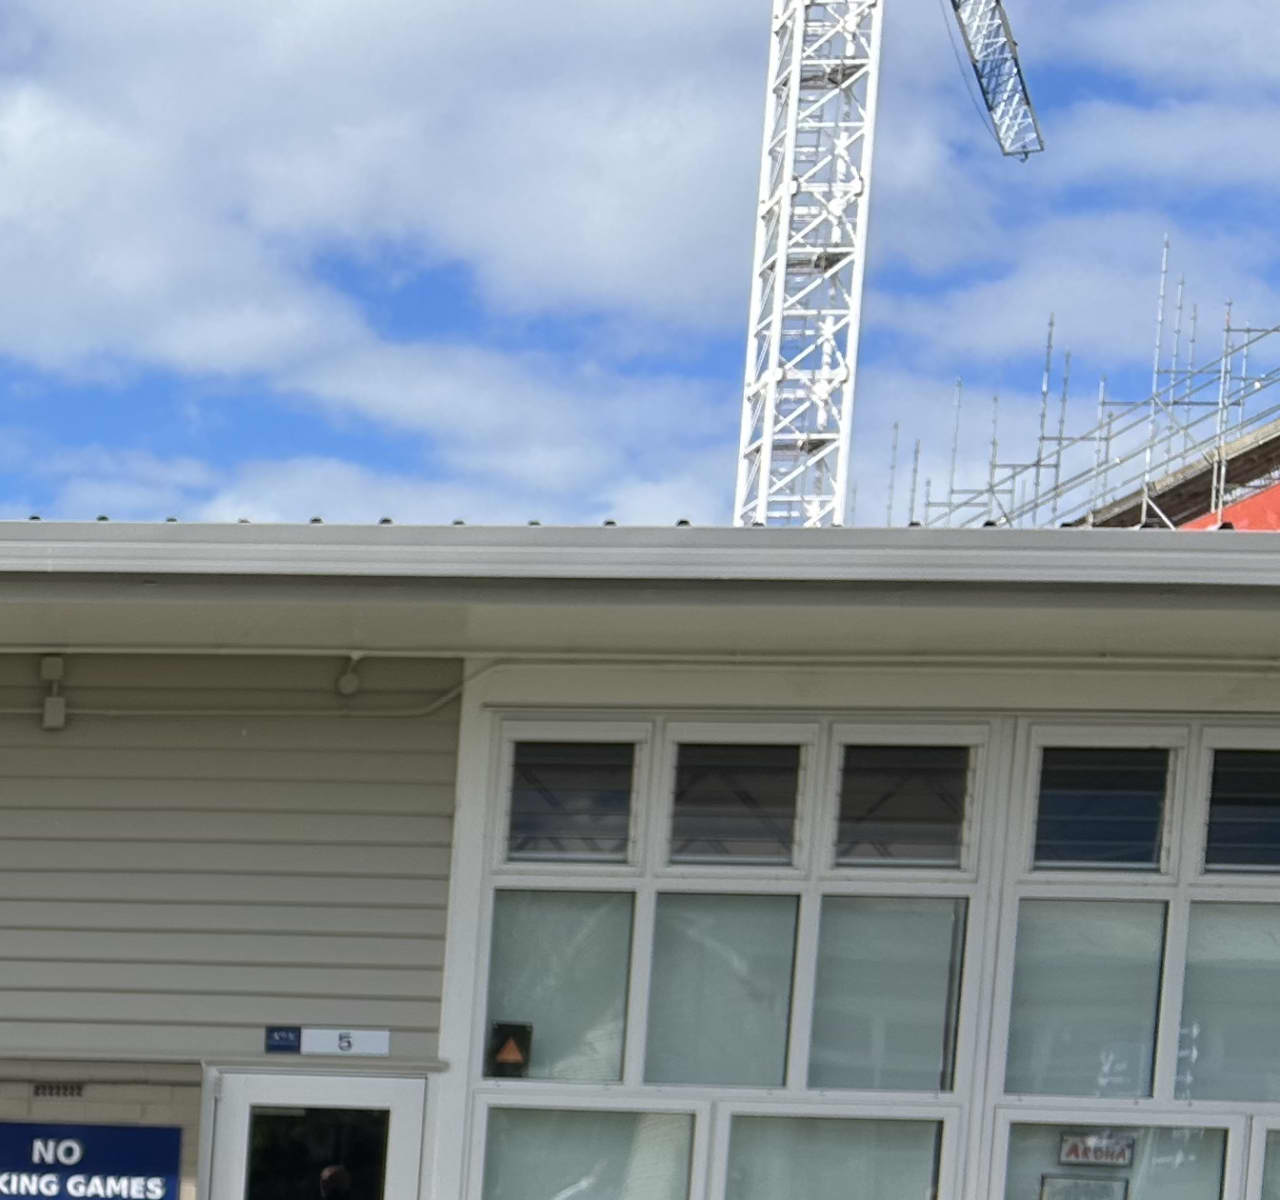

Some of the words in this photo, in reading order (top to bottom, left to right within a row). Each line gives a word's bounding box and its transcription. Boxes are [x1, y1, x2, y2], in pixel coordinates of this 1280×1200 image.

[338, 1032, 352, 1051] 5
[32, 1138, 82, 1165] NO
[66, 1174, 166, 1200] GAMES
